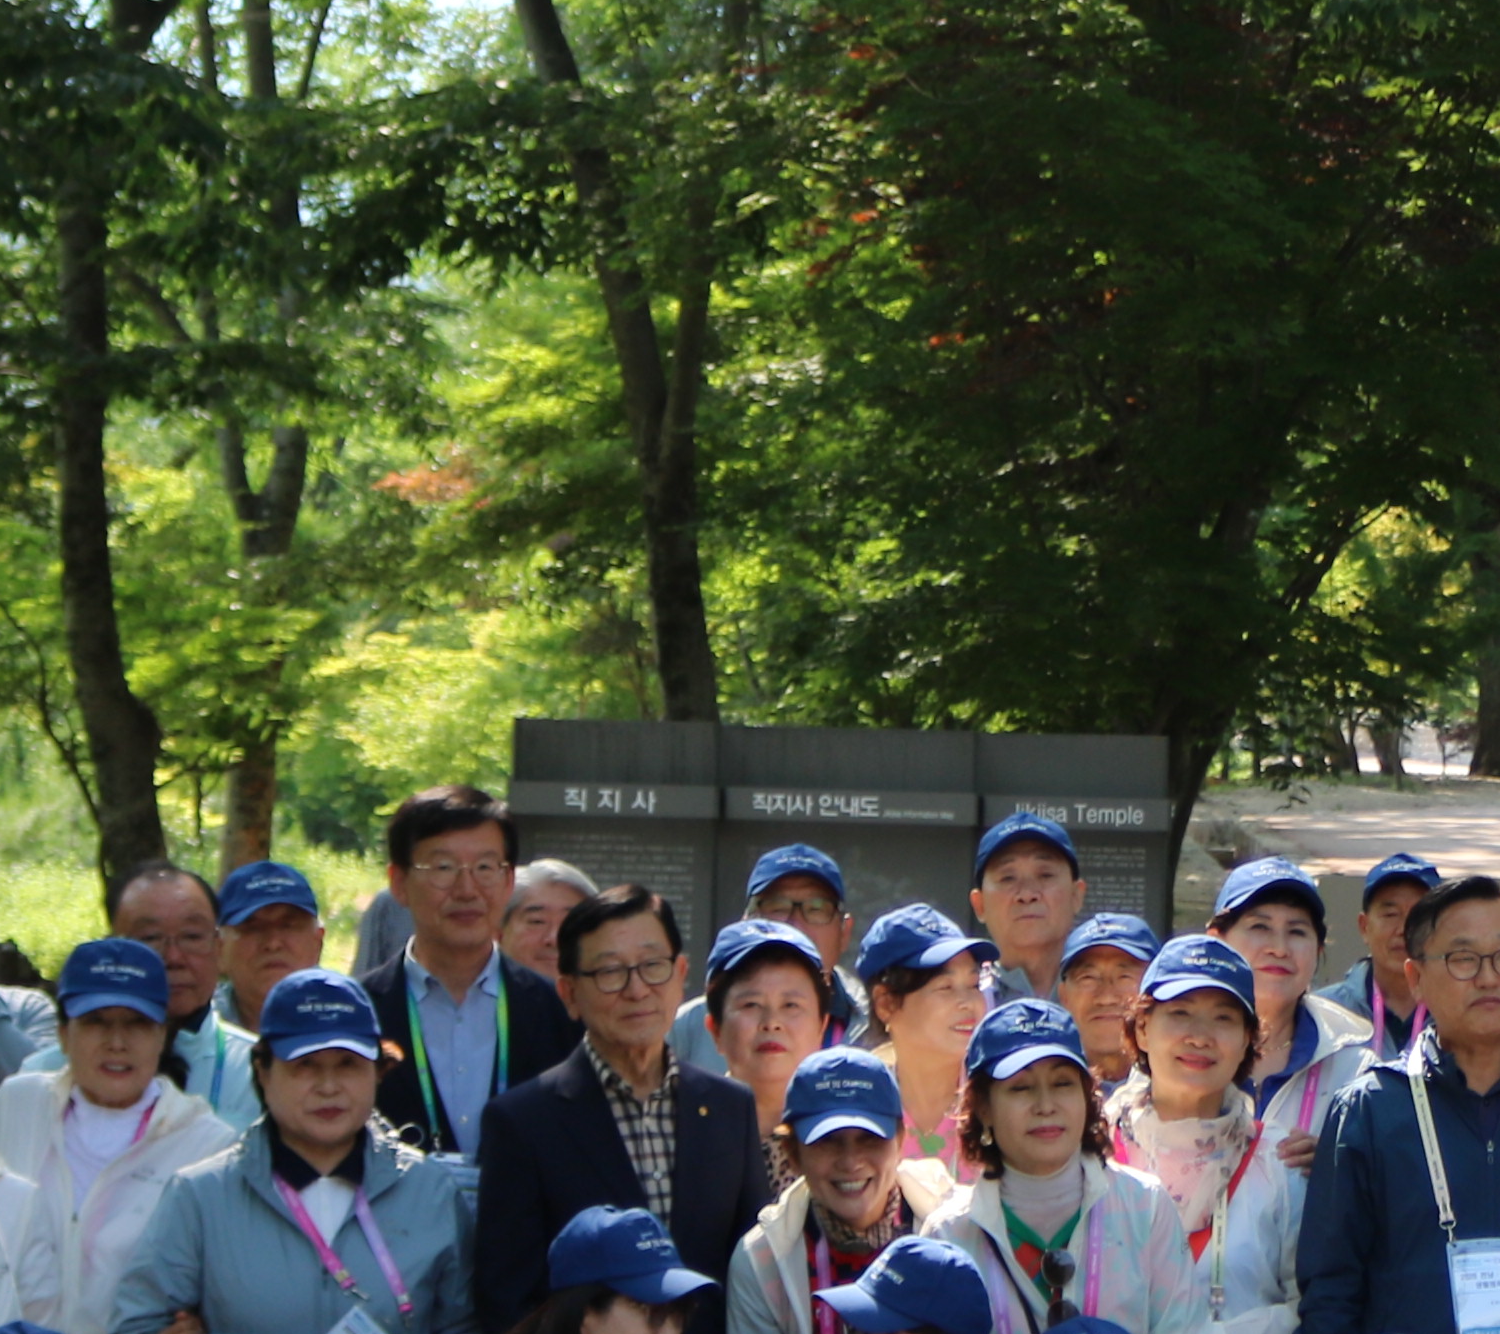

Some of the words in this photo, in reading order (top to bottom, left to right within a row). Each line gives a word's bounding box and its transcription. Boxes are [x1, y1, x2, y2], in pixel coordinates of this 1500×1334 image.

[563, 787, 657, 813] 직지사
[752, 793, 813, 816] 직지사
[818, 794, 879, 817] 안내도
[1074, 803, 1144, 827] Temple
